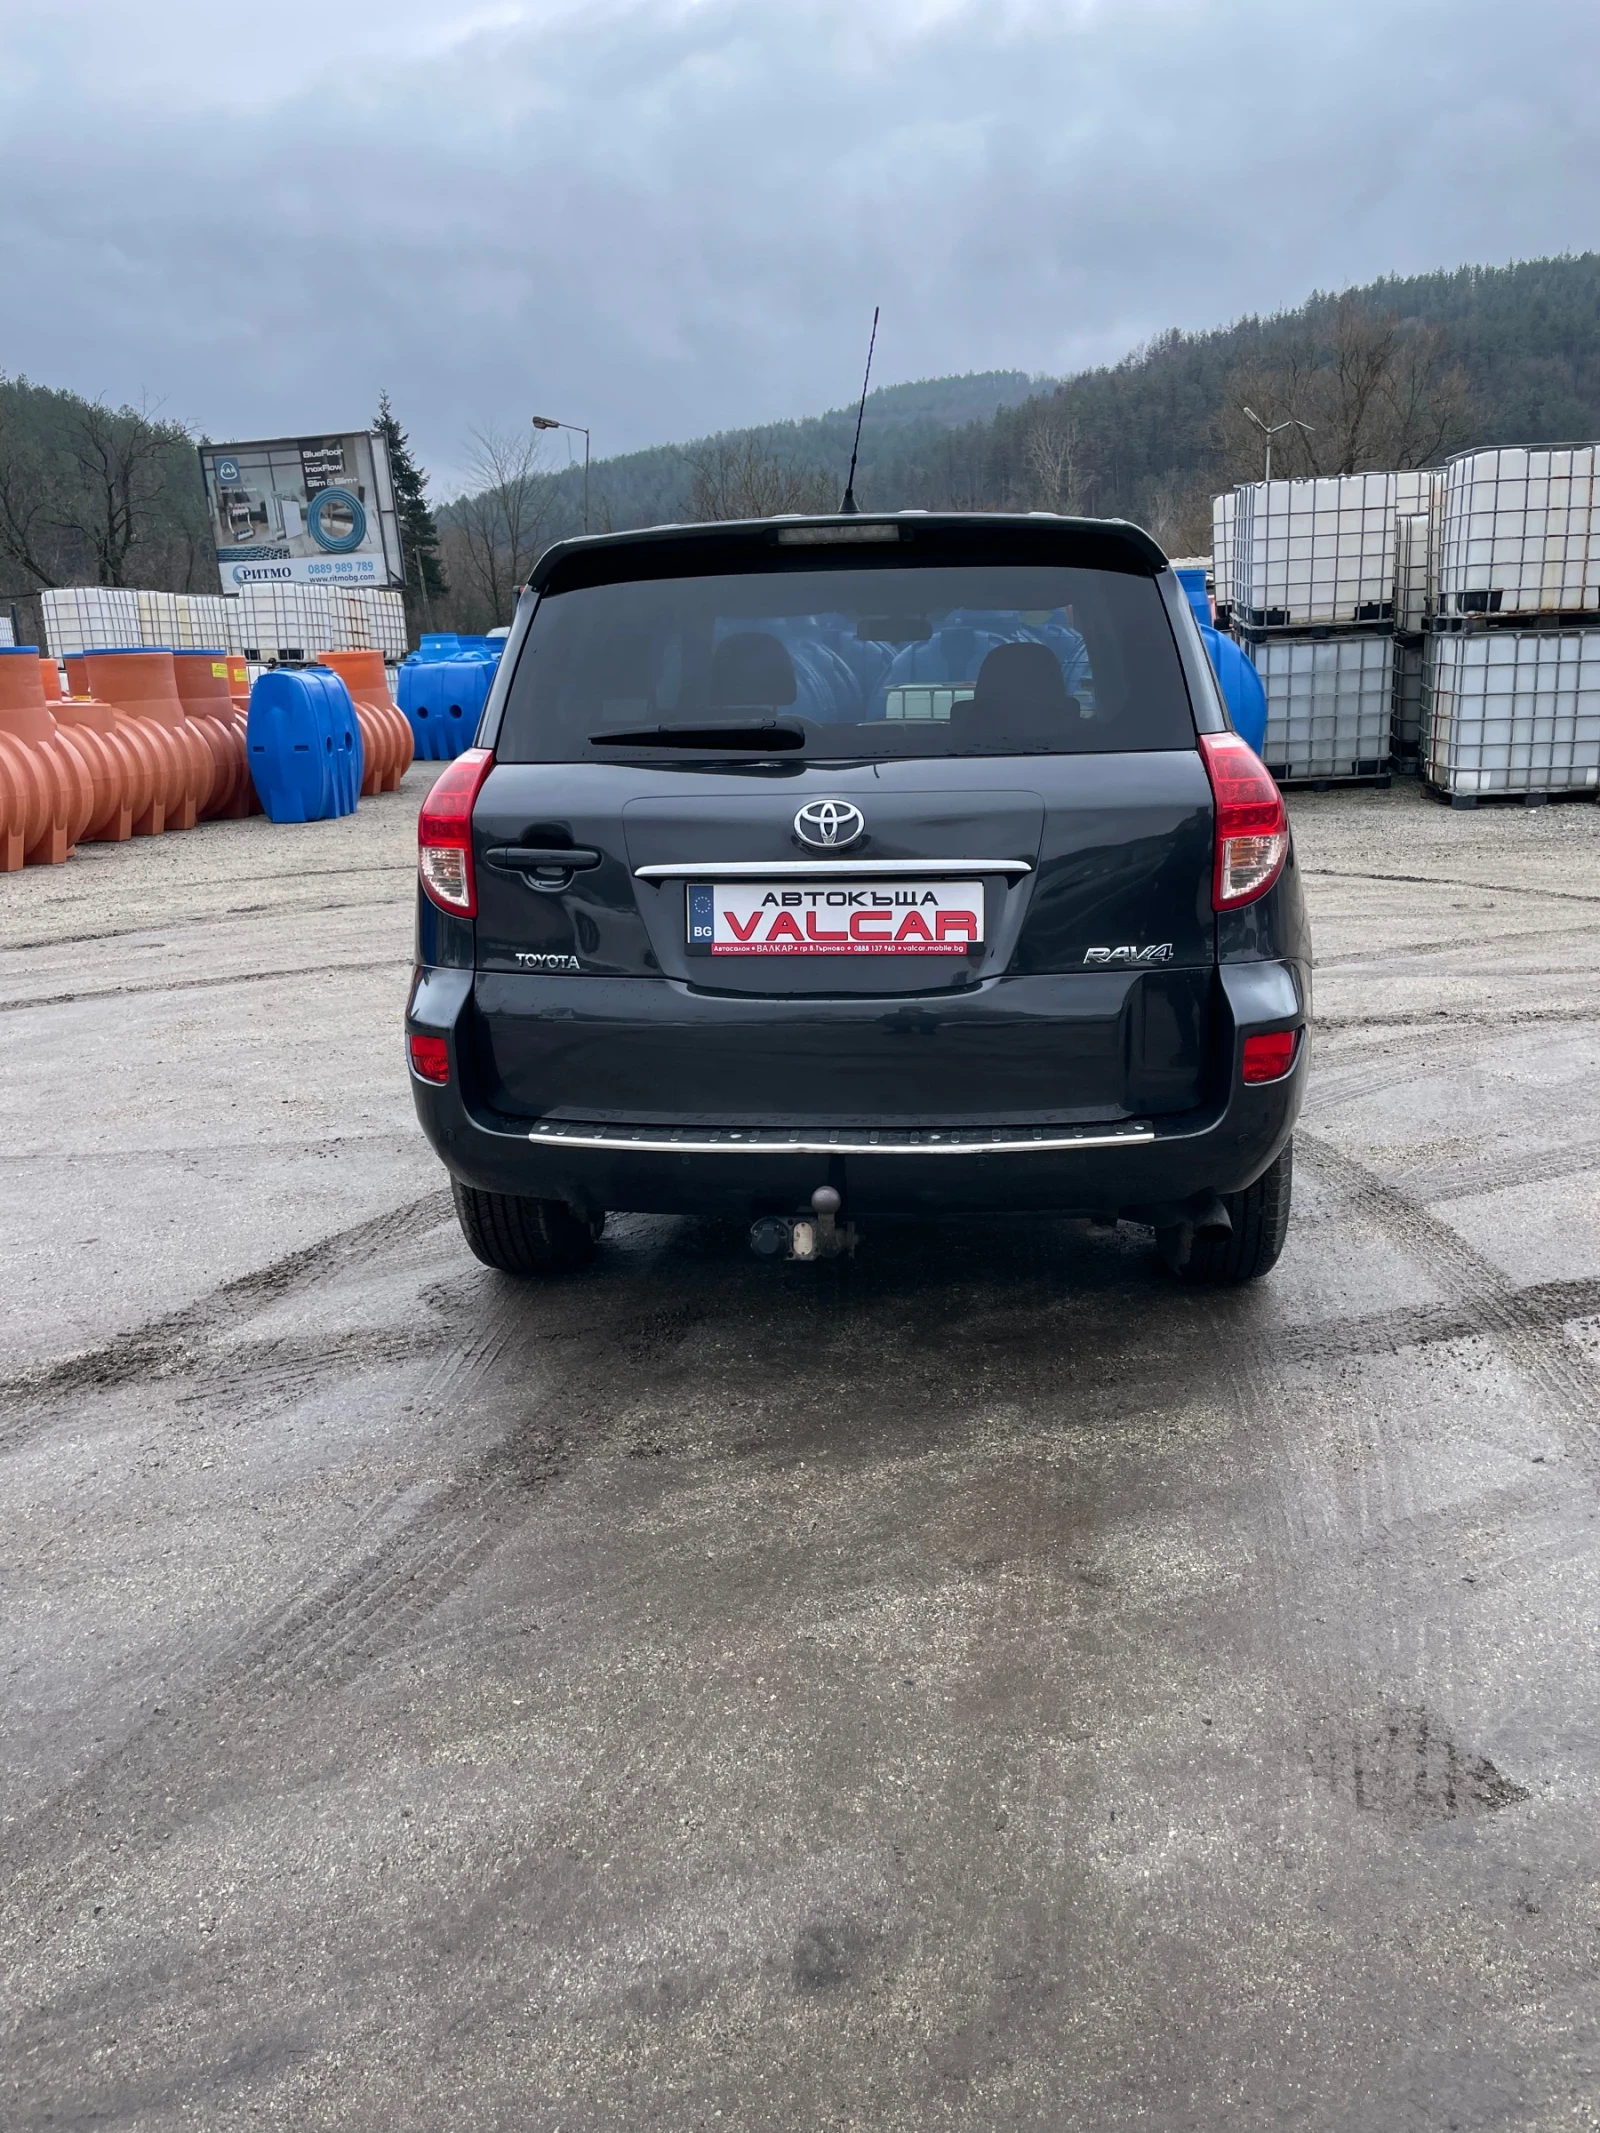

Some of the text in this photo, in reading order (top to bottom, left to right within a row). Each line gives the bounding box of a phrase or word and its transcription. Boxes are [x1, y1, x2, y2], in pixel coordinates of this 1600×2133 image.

[302, 449, 343, 458] BlueFloor
[305, 464, 342, 473] InoxFlow
[242, 567, 292, 580] РИТМО
[308, 561, 374, 574] 0889 989 789
[309, 573, 375, 583] www.ritmobg.com
[694, 926, 712, 937] BG
[723, 910, 978, 941] VALCAR
[756, 944, 793, 953] ВАЛКАР
[903, 944, 964, 953] valcar.mobile.bg
[1082, 943, 1174, 964] RAV4
[515, 952, 580, 970] TOYOTA
